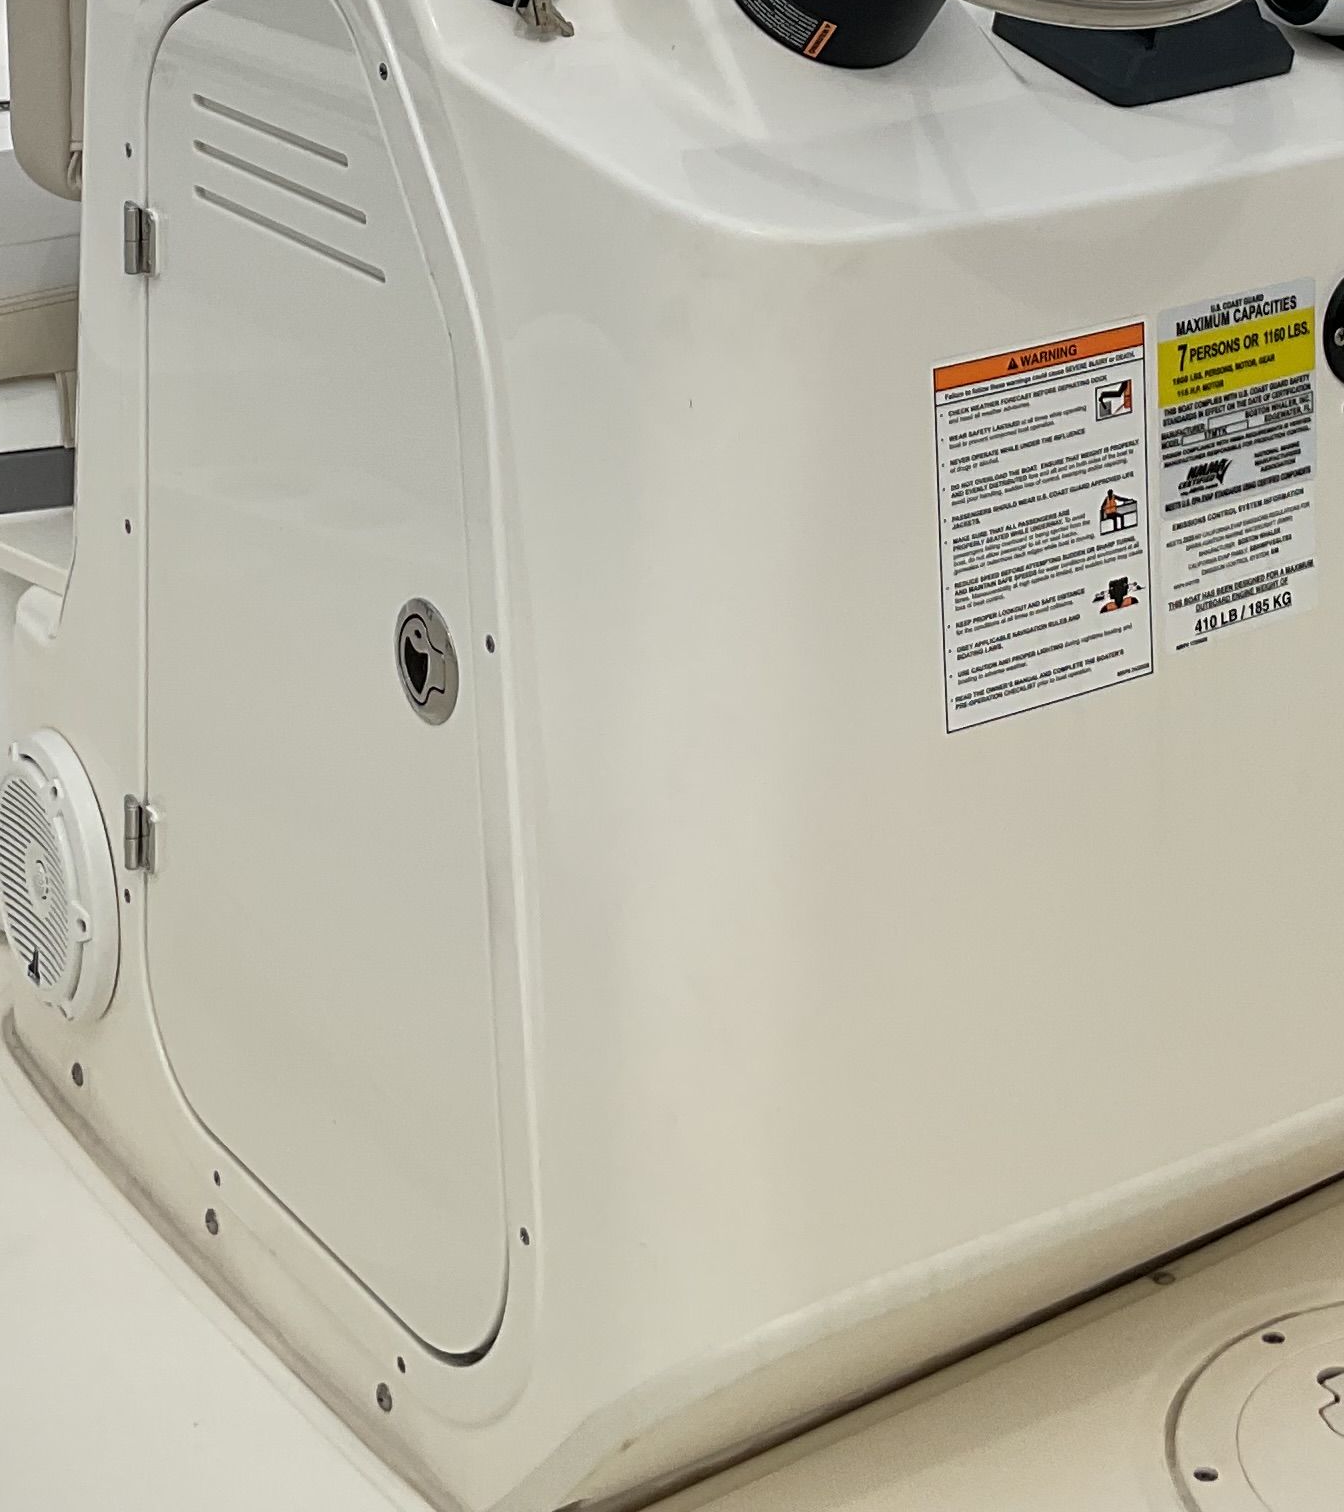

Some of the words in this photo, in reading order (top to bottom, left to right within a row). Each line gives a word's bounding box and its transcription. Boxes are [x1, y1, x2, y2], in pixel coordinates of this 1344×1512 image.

[1176, 310, 1229, 336] MAXIMUM
[1233, 295, 1297, 323] CAPACITIES
[1021, 344, 1077, 367] WARNING
[1178, 344, 1188, 372] 7
[1190, 337, 1240, 363] PERSONS
[1243, 332, 1259, 350] OR
[1264, 326, 1285, 345] 1160
[1288, 321, 1310, 339] LBS.
[1195, 614, 1217, 634] 410
[1221, 607, 1237, 625] LB
[1240, 604, 1246, 619] /
[1249, 597, 1269, 617] 185
[1273, 590, 1292, 609] KG
